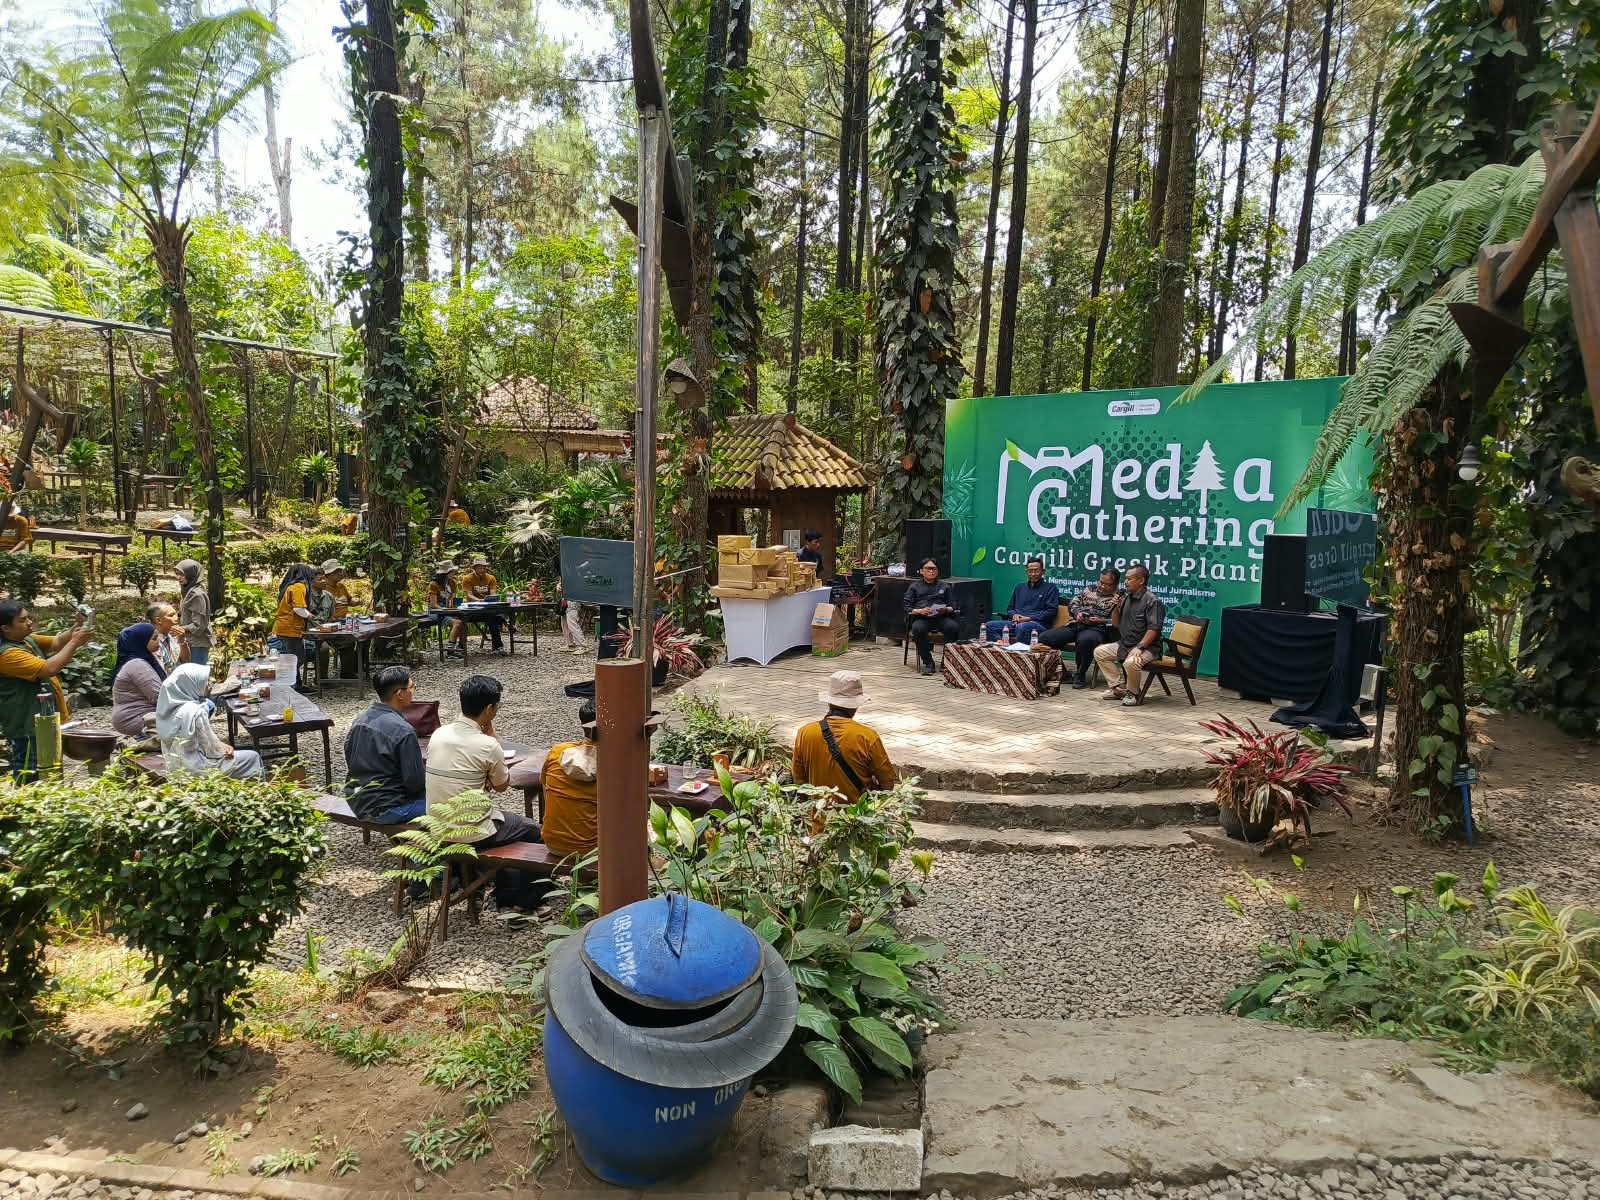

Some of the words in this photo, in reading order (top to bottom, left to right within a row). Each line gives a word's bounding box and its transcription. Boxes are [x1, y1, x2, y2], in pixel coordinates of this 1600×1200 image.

[1027, 478, 1275, 560] Gathering
[1179, 556, 1260, 583] Plant
[1048, 576, 1085, 587] Mengawal
[1169, 585, 1217, 598] Jurnalisme
[655, 1100, 696, 1123] NON
